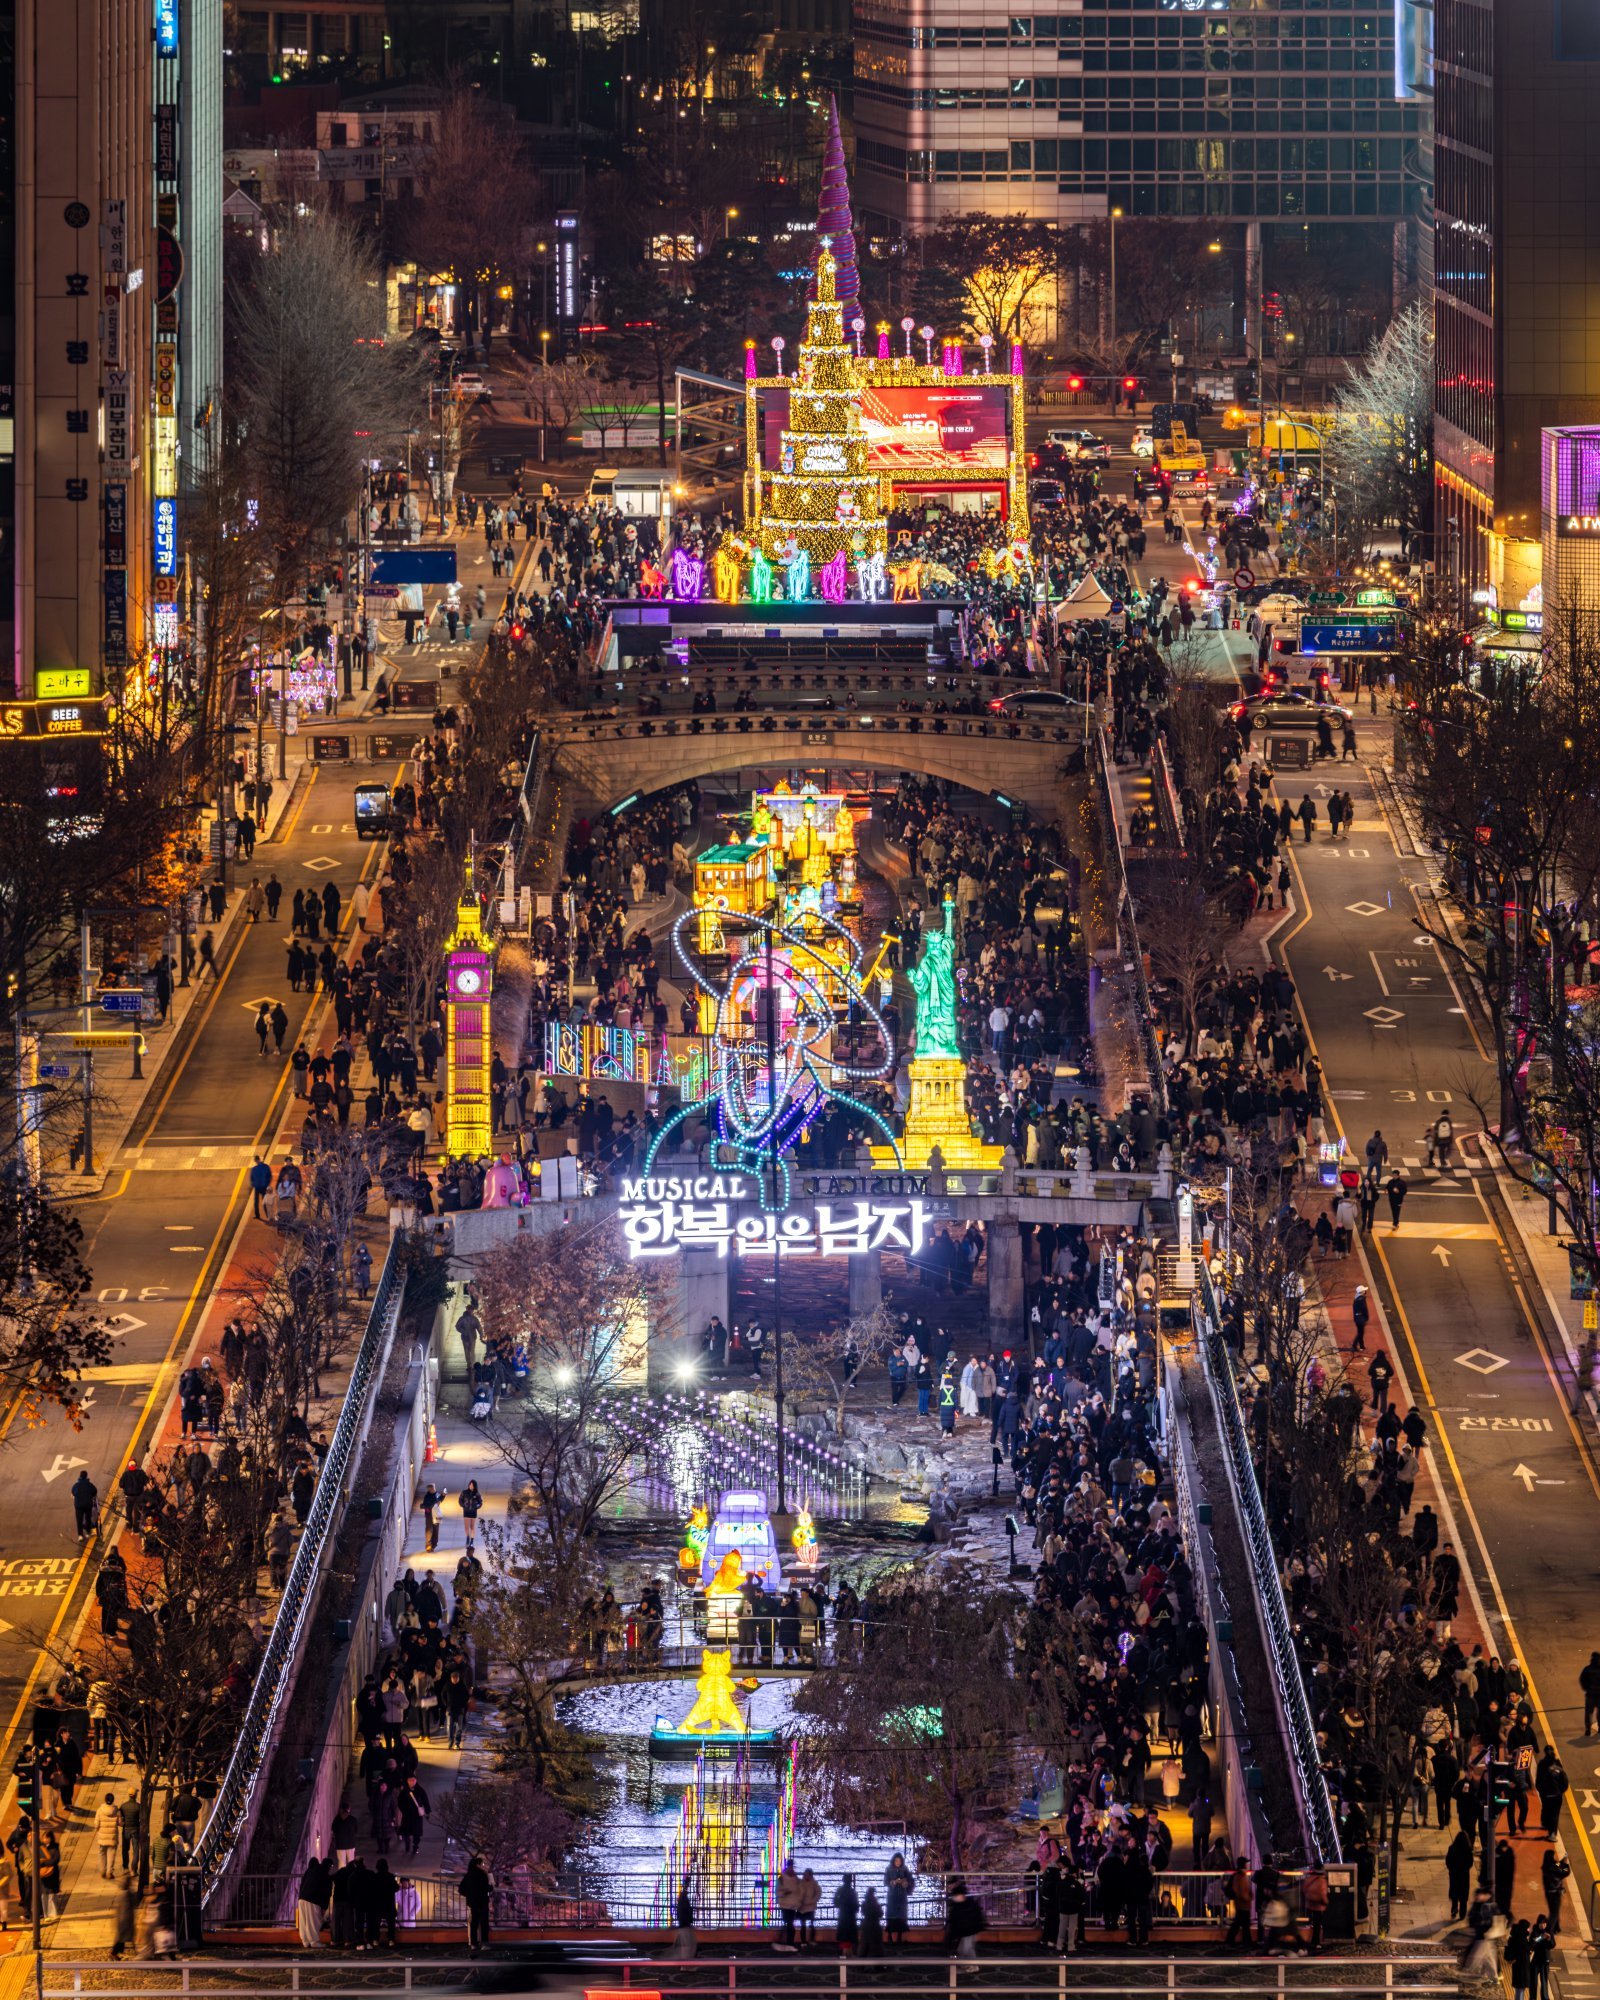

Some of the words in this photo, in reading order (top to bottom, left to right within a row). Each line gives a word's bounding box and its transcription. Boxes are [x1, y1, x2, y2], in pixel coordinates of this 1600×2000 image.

[160, 241, 174, 288] BAR
[902, 419, 939, 435] 150
[1526, 614, 1544, 628] CU
[1335, 629, 1362, 639] 무교로
[45, 674, 84, 691] 고바우
[52, 708, 79, 721] BEER
[48, 720, 83, 733] COFFEE
[1318, 848, 1371, 859] 30
[1389, 1089, 1453, 1103] 30
[621, 1177, 746, 1201] MUSICAL
